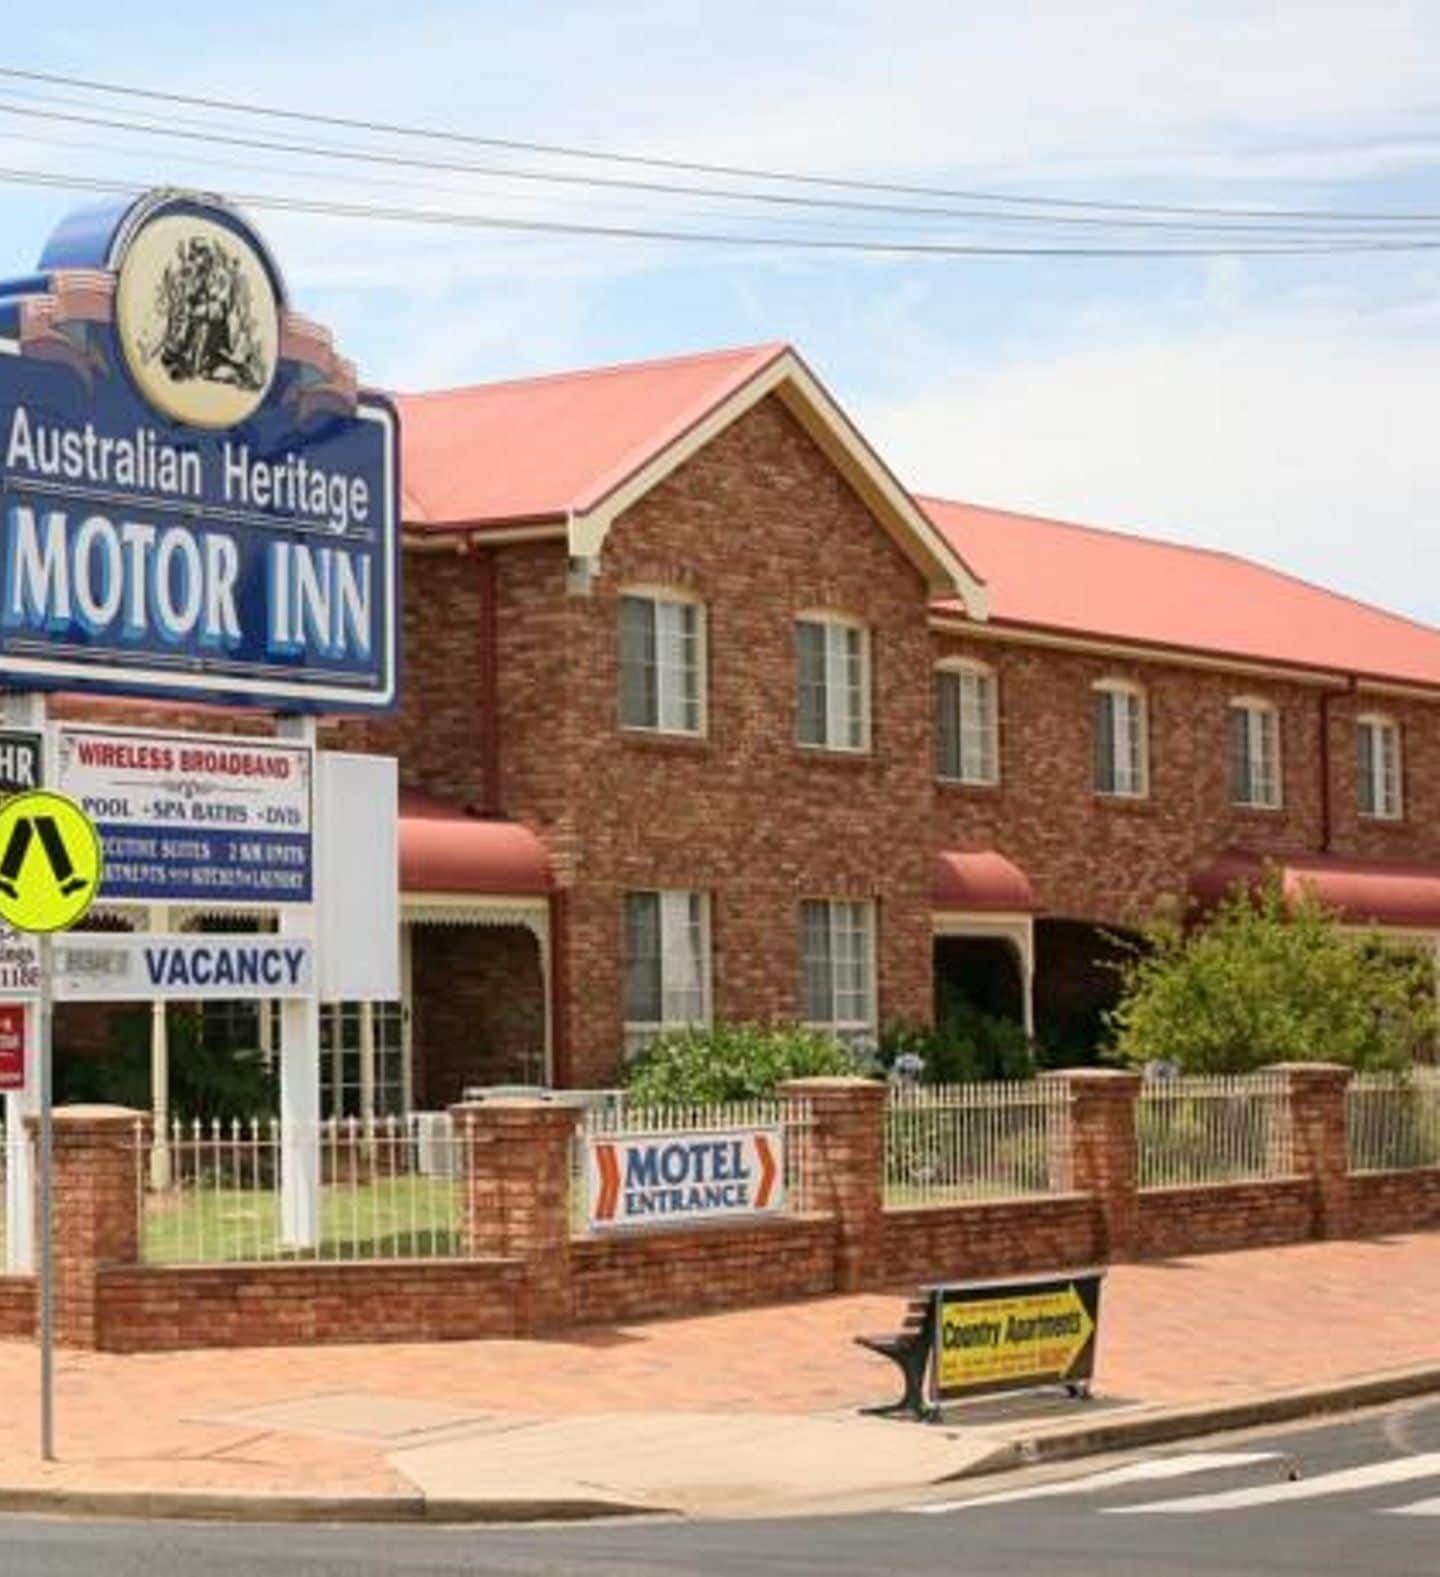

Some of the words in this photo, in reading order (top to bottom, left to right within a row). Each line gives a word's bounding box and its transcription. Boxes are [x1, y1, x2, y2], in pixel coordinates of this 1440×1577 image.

[6, 407, 202, 496] Australian
[224, 441, 369, 534] Heritage
[6, 506, 243, 643] MOTOR
[267, 541, 372, 660] INN
[78, 742, 174, 771] WIRELESS
[180, 750, 290, 779] BROADBAND
[81, 797, 132, 816] POOL
[192, 802, 248, 822] BATHS
[101, 837, 158, 858] ECUTIVE
[145, 947, 306, 986] VACANCY
[626, 1141, 750, 1187] MOTEL
[625, 1183, 748, 1215] ENTRANCE
[943, 1318, 1002, 1349] Country
[1005, 1311, 1082, 1345] Apartments
